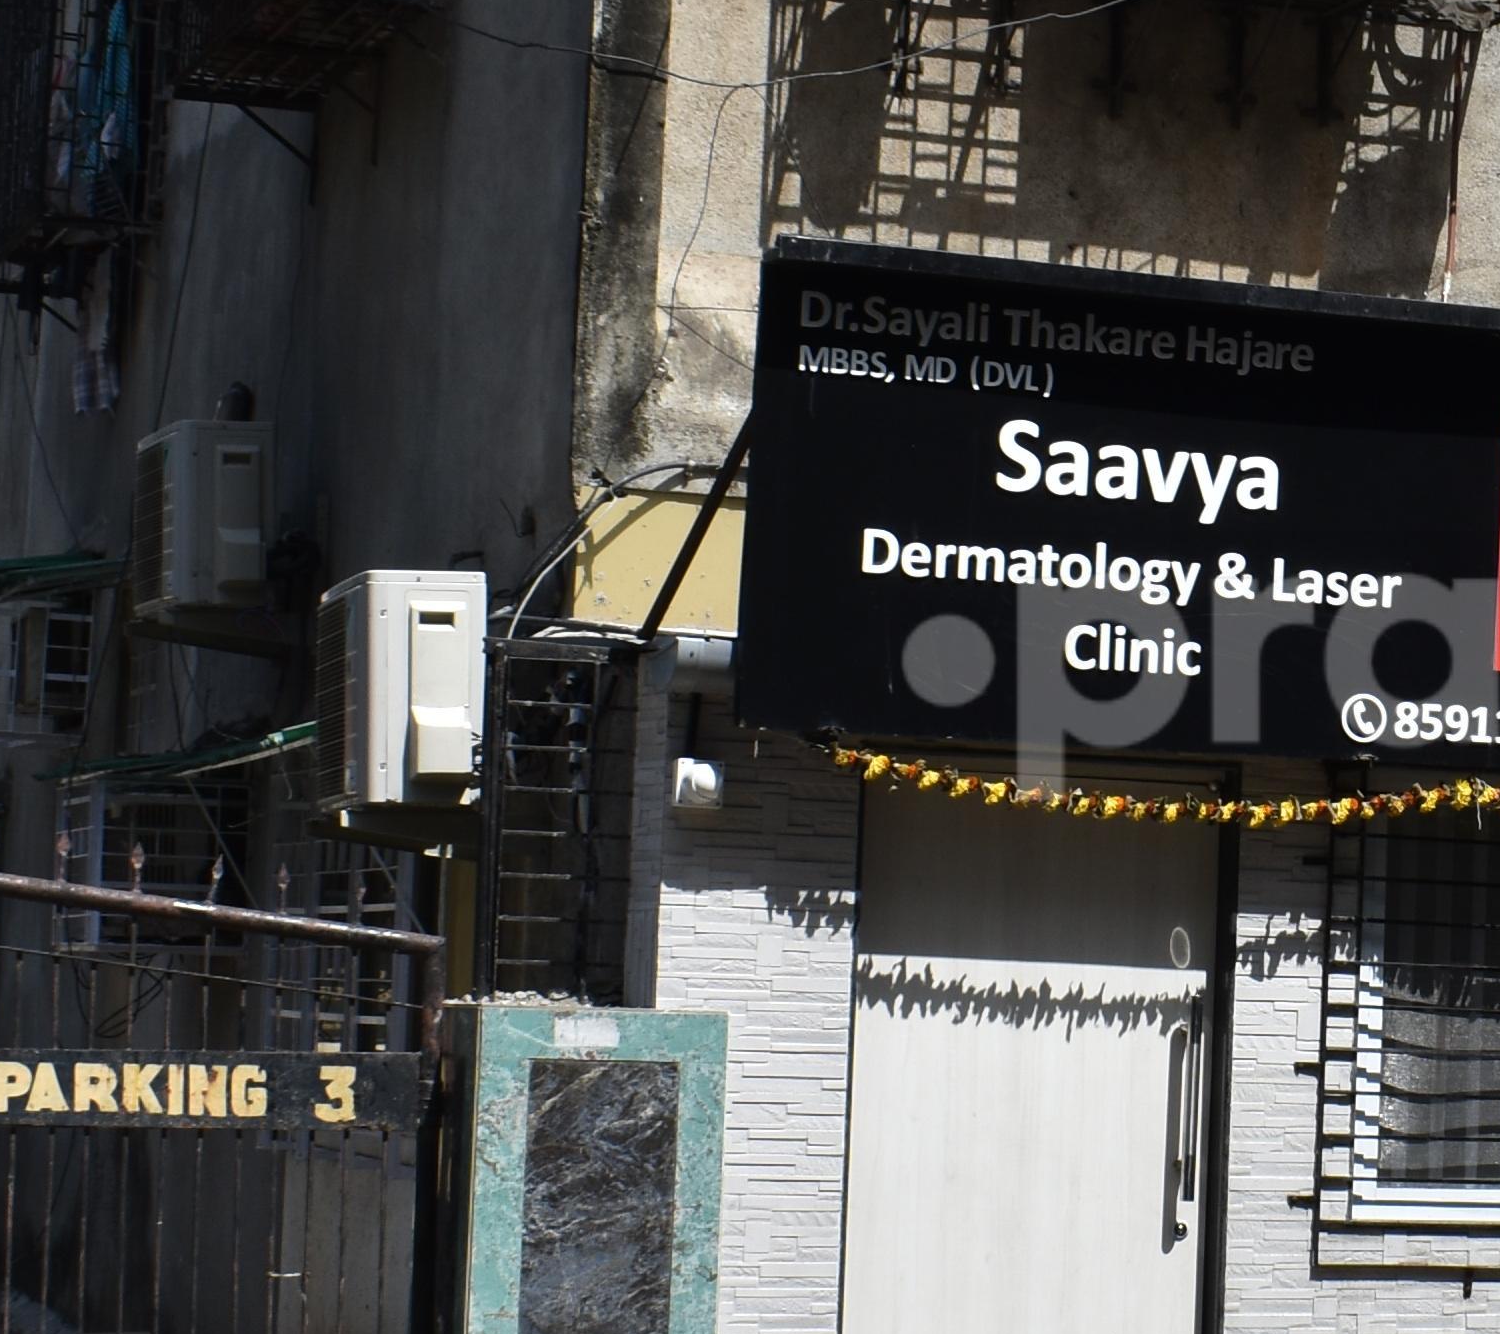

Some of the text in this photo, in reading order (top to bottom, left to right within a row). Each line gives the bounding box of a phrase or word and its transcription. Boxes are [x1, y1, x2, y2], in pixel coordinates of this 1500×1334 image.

[797, 288, 1317, 377] Dr.Sayali Thakare Hajare
[797, 344, 1056, 398] MBBS, MD (DVL)
[996, 419, 1281, 525] Saavya
[861, 527, 1402, 609] Dermatology & Laser
[1064, 622, 1202, 677] Clinic
[313, 1065, 356, 1123] 3
